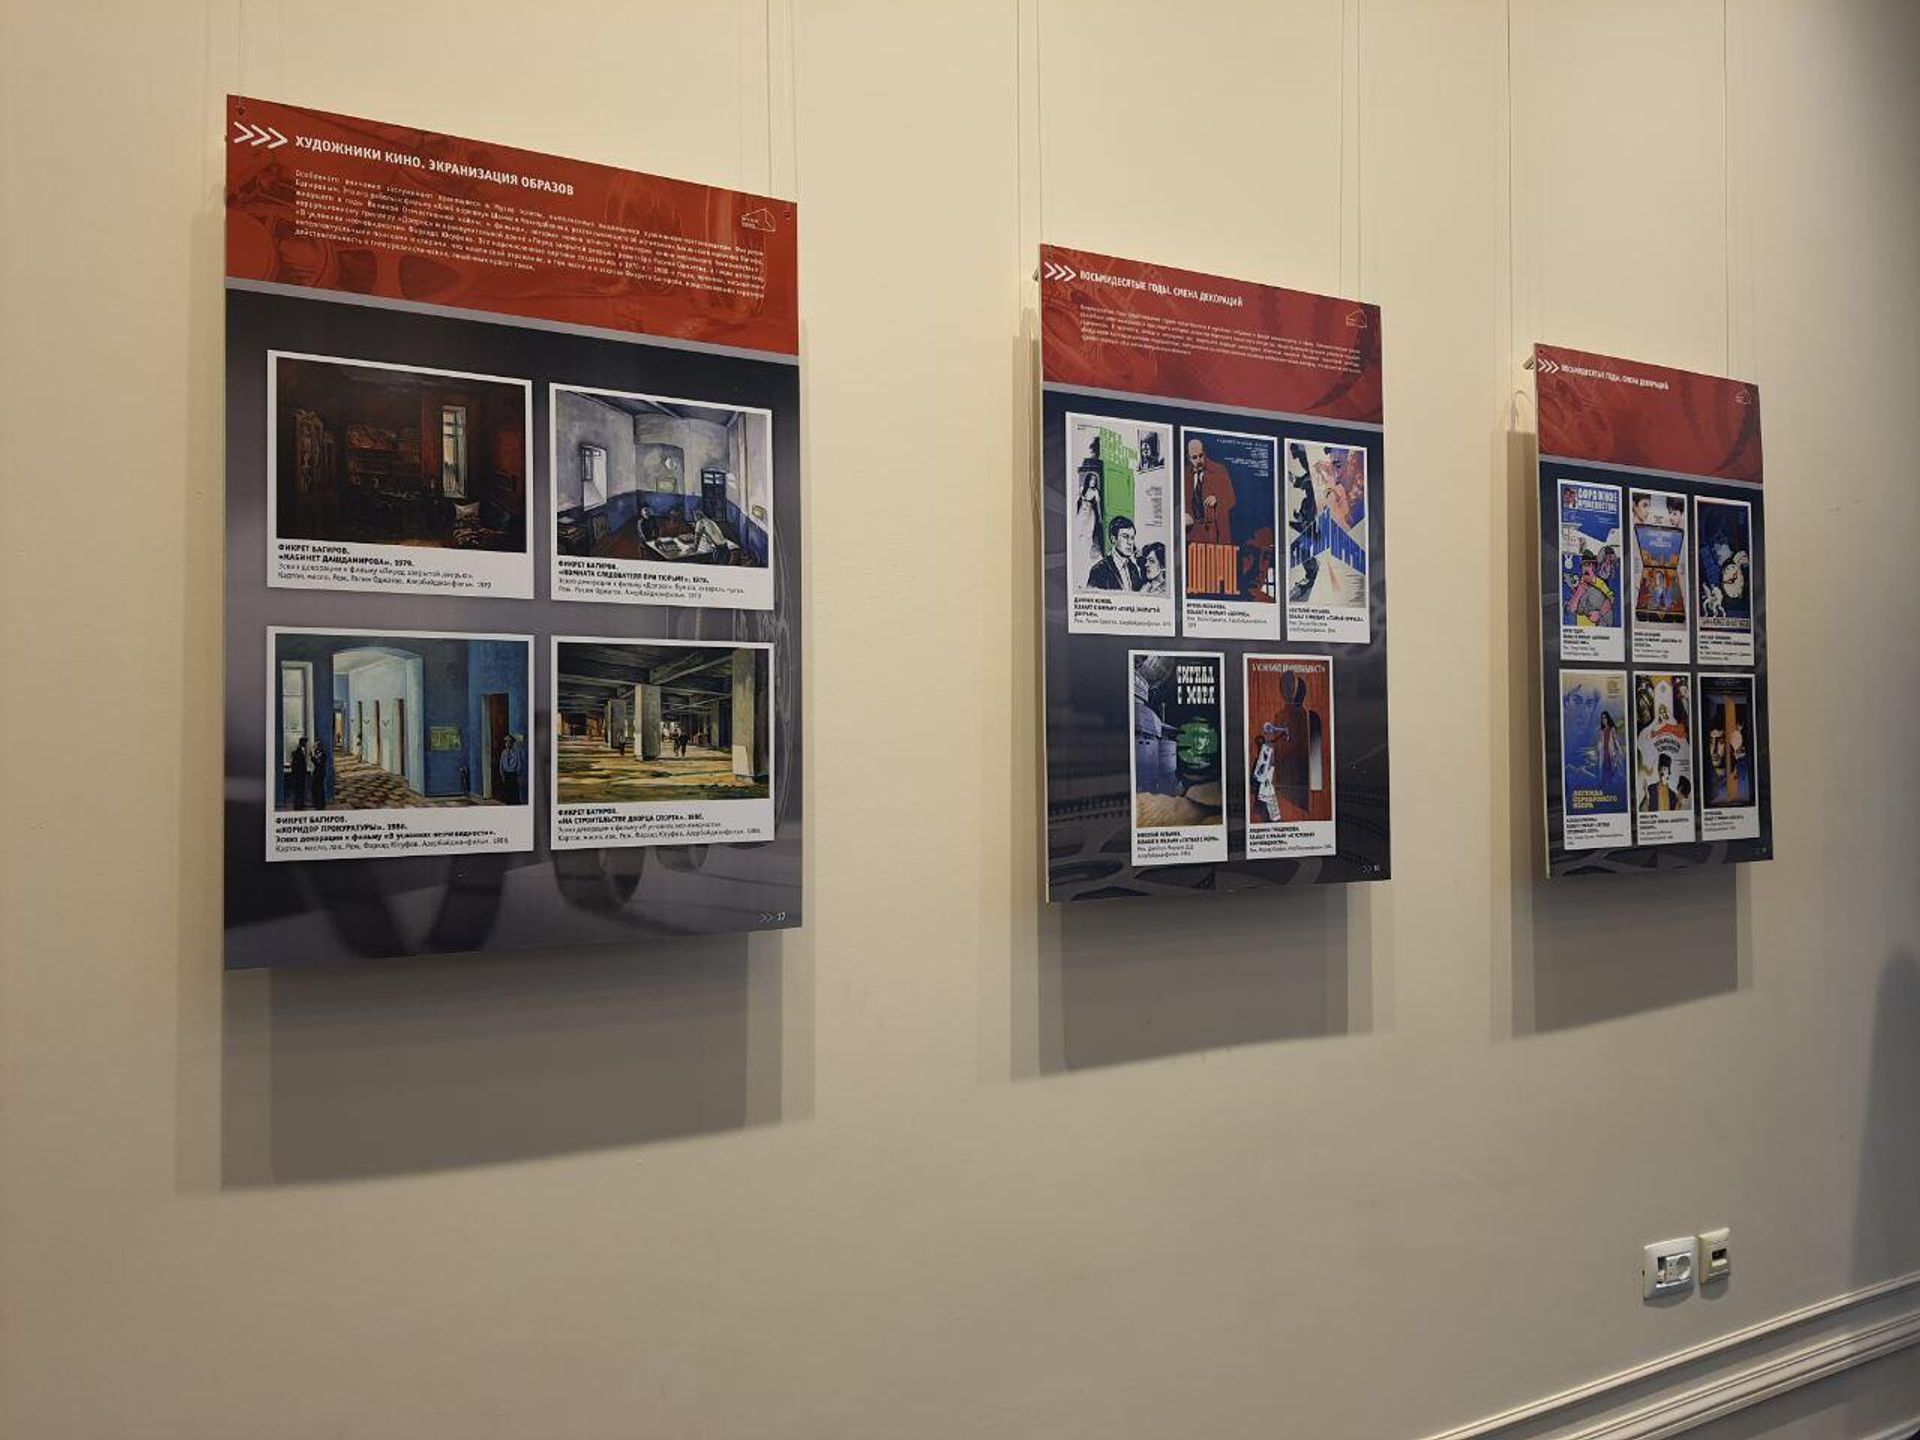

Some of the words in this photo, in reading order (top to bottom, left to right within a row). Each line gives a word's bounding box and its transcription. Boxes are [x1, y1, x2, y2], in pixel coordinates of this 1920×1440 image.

[295, 134, 380, 160] ХУДОЖНИКИ
[385, 150, 424, 169] КИНО.
[428, 158, 518, 185] ЭКРАНИЗАЦИЯ
[520, 175, 573, 195] ОБРАЗОВ
[275, 816, 307, 824] ФИКРЕТ
